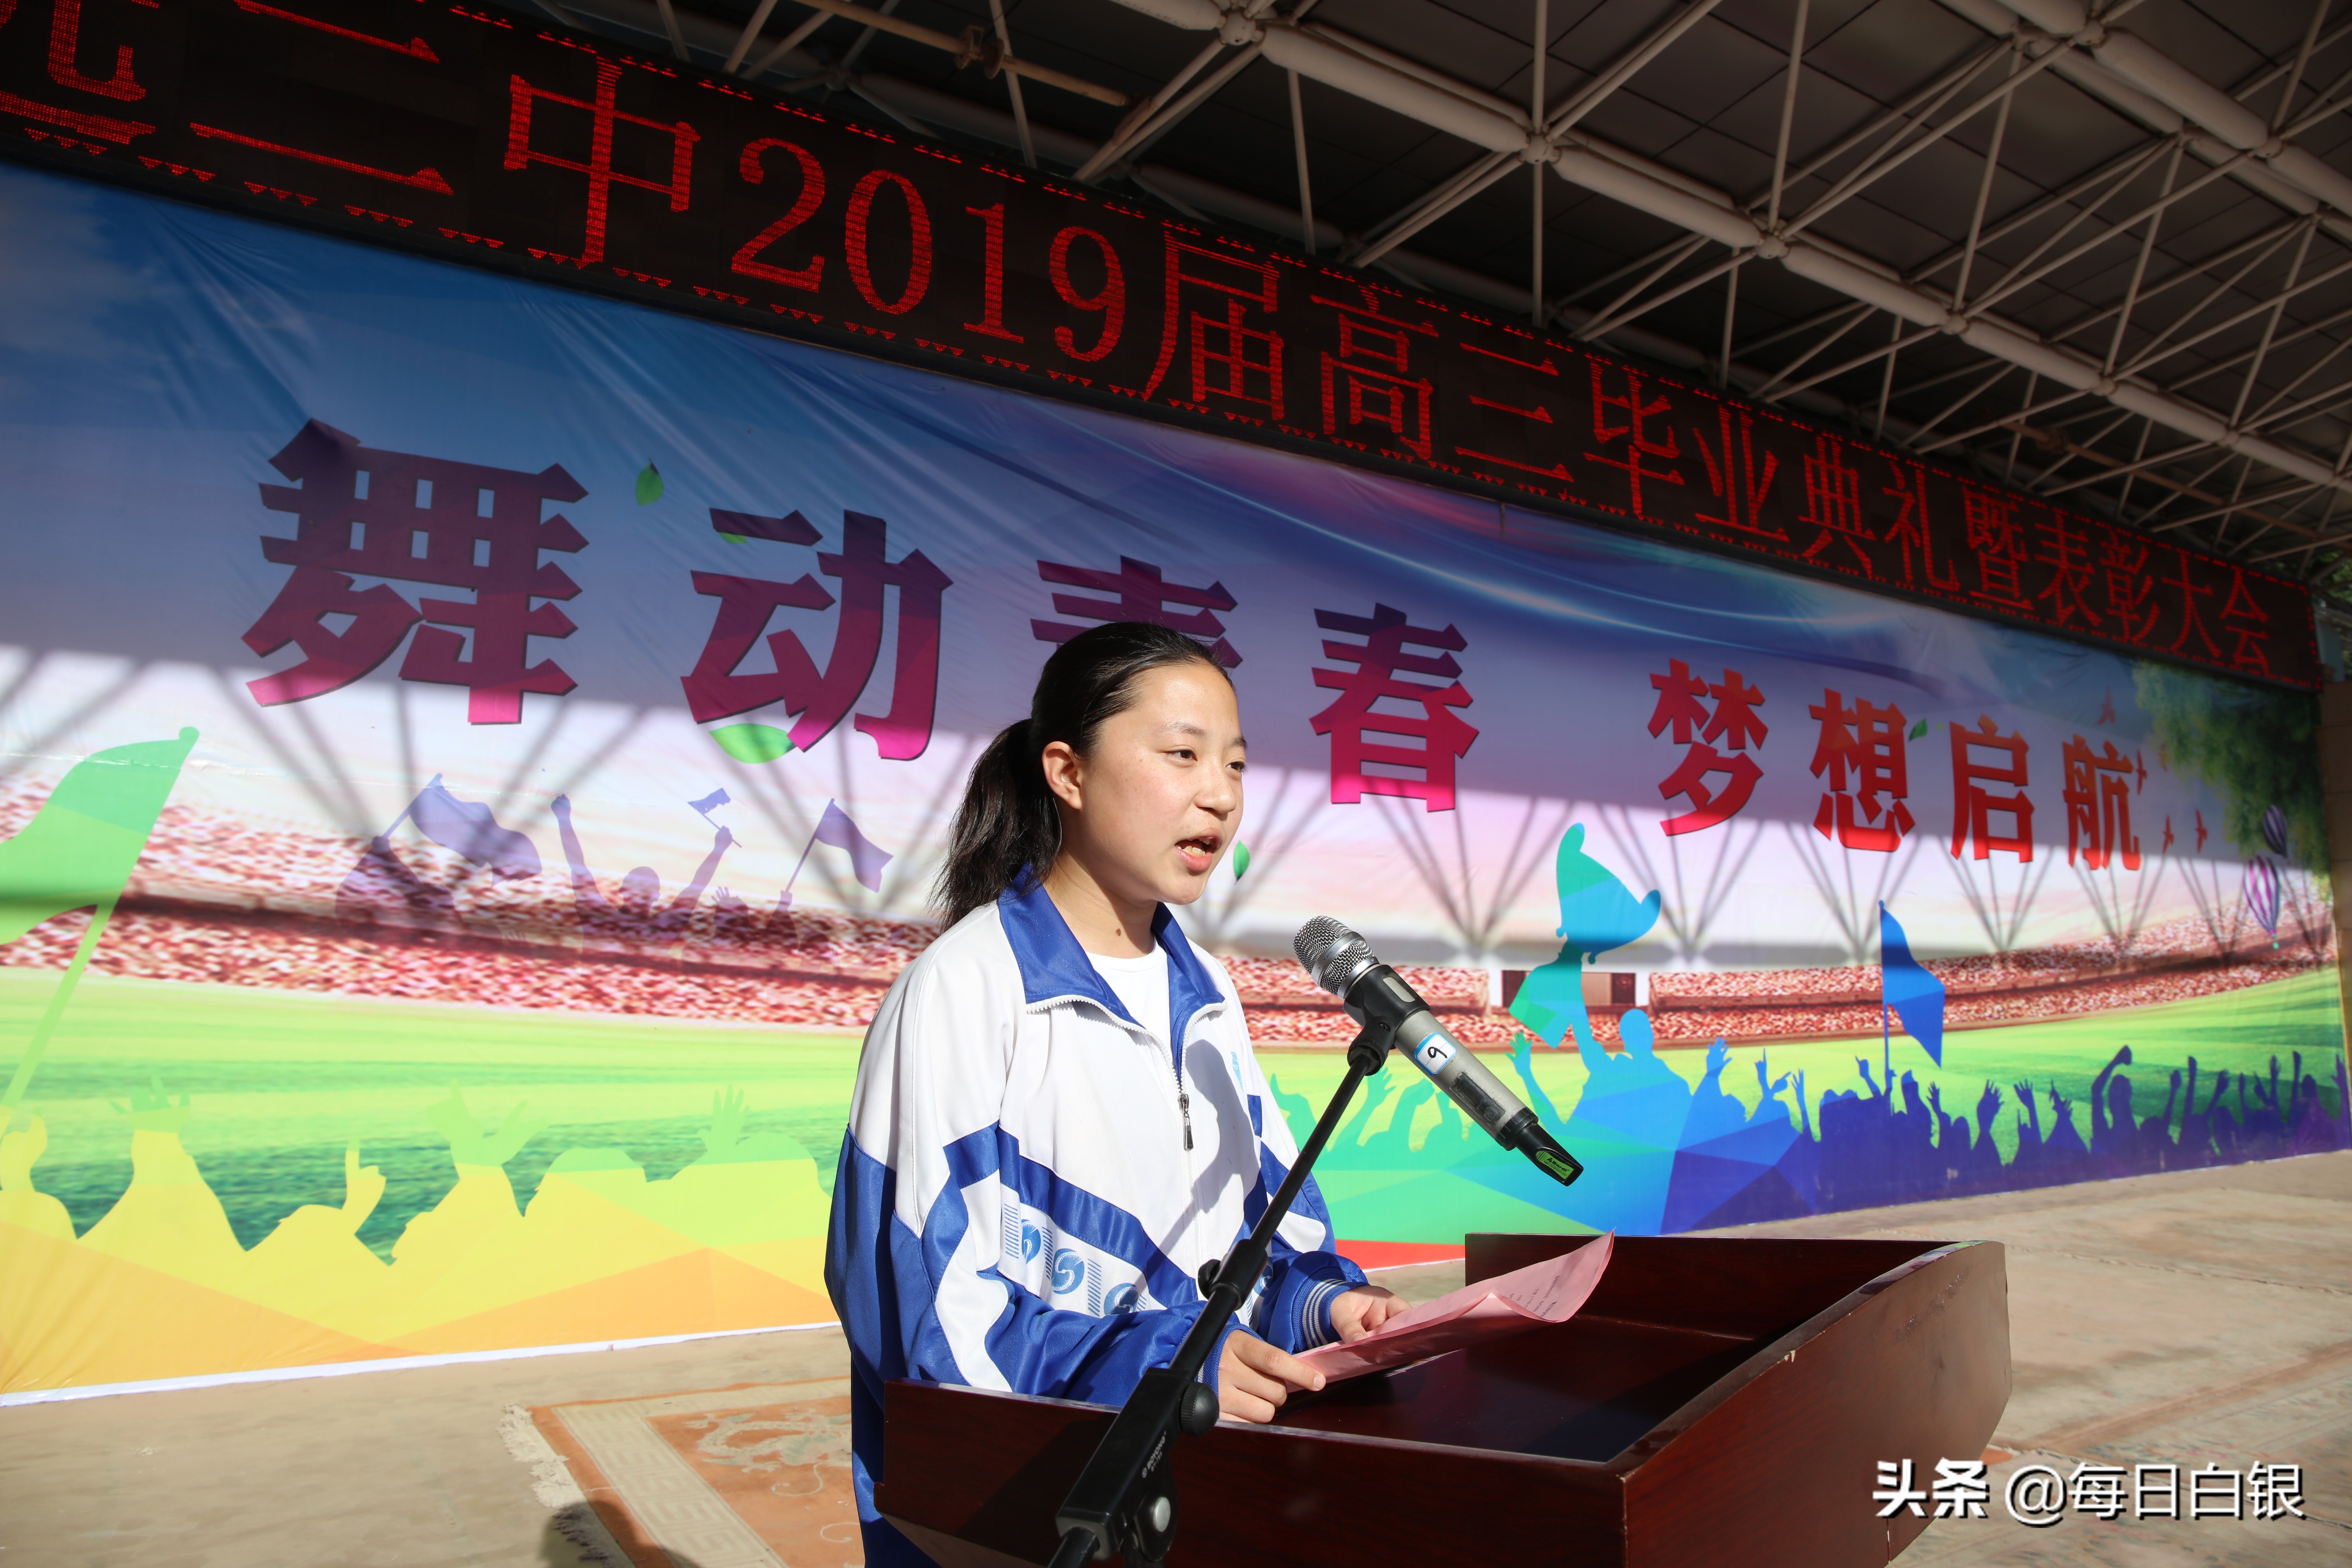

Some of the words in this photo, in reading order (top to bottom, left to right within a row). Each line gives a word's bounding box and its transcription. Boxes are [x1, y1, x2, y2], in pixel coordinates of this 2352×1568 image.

[1647, 658, 2142, 871] 梦想启航
[1428, 1046, 1448, 1058] 9
[1147, 1436, 1165, 1470] BOYONG
